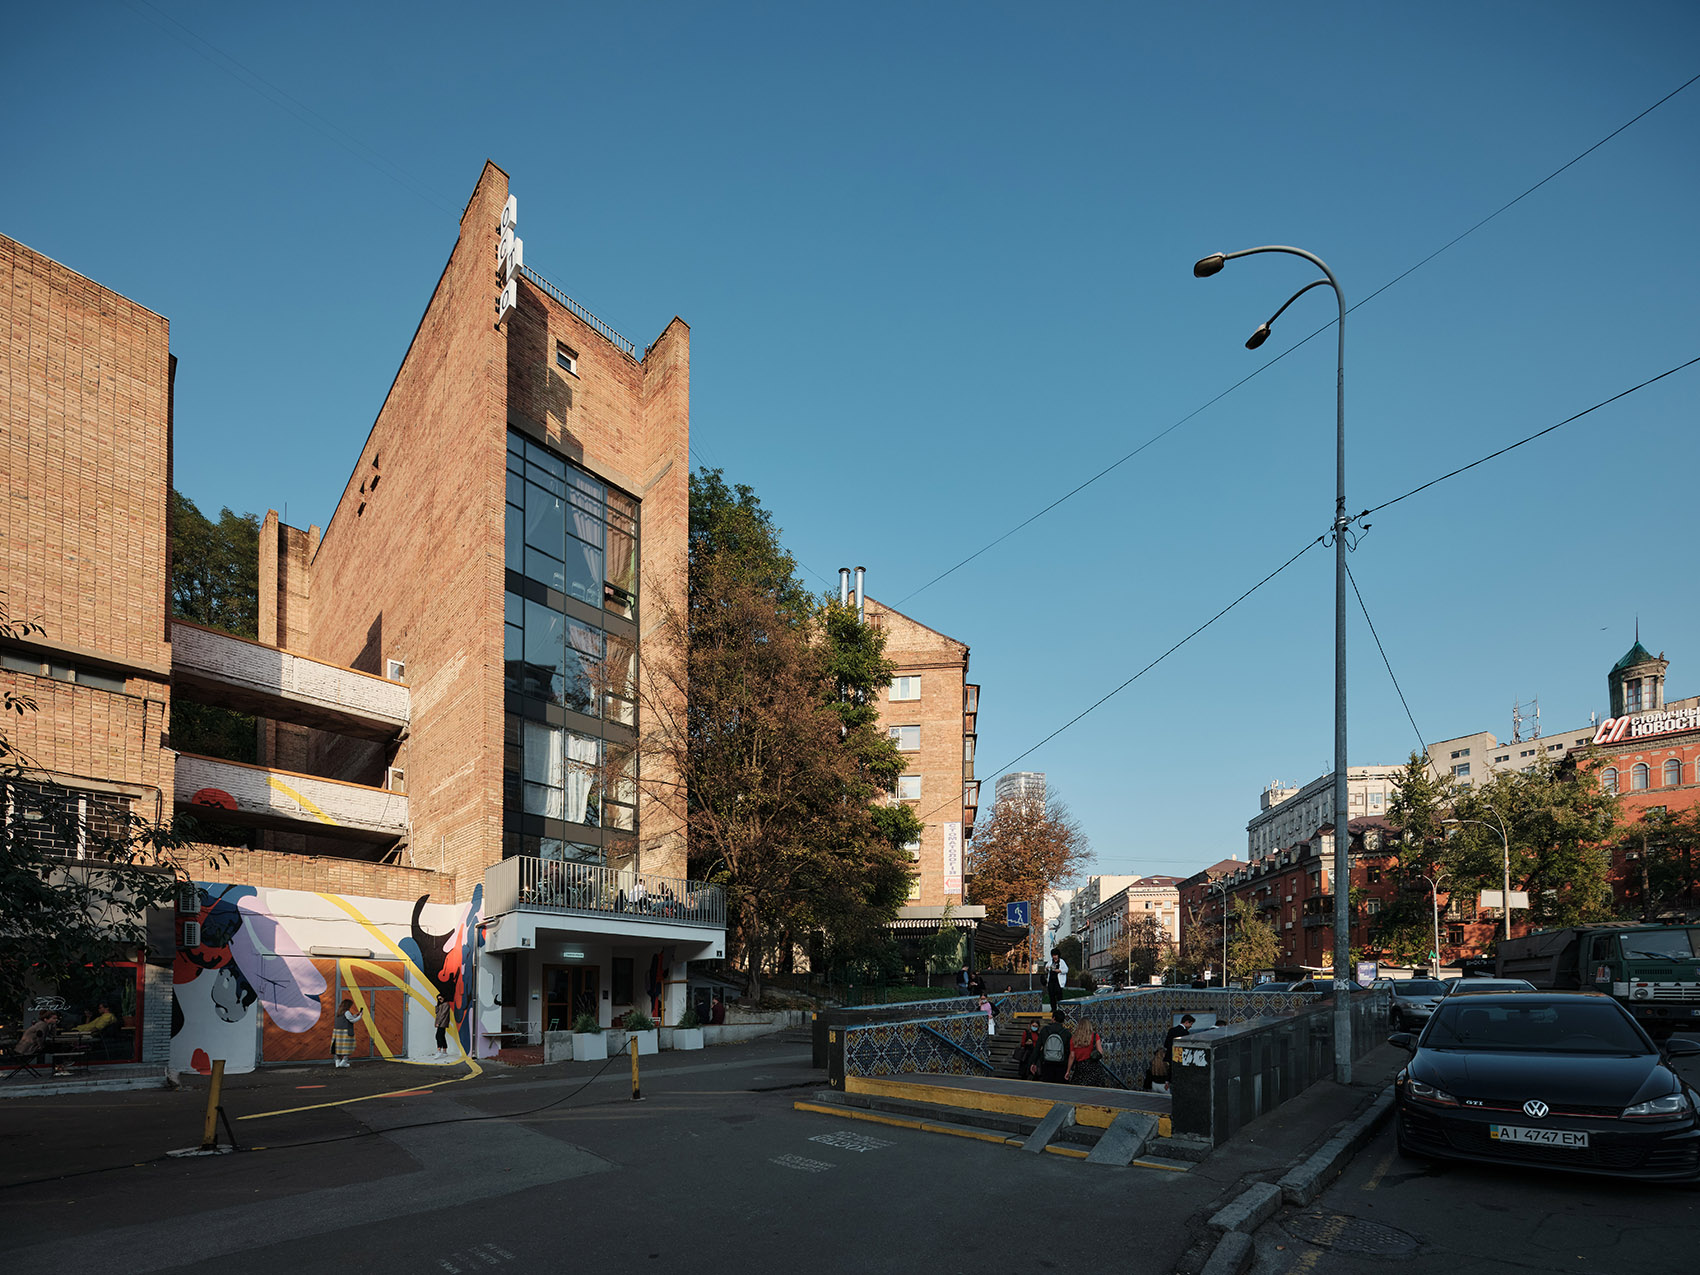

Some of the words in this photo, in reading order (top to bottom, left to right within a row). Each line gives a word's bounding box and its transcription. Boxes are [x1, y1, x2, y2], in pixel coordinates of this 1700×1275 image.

[1500, 1127, 1517, 1139] AI
[1524, 1129, 1559, 1143] 4747
[1562, 1133, 1585, 1145] EM
